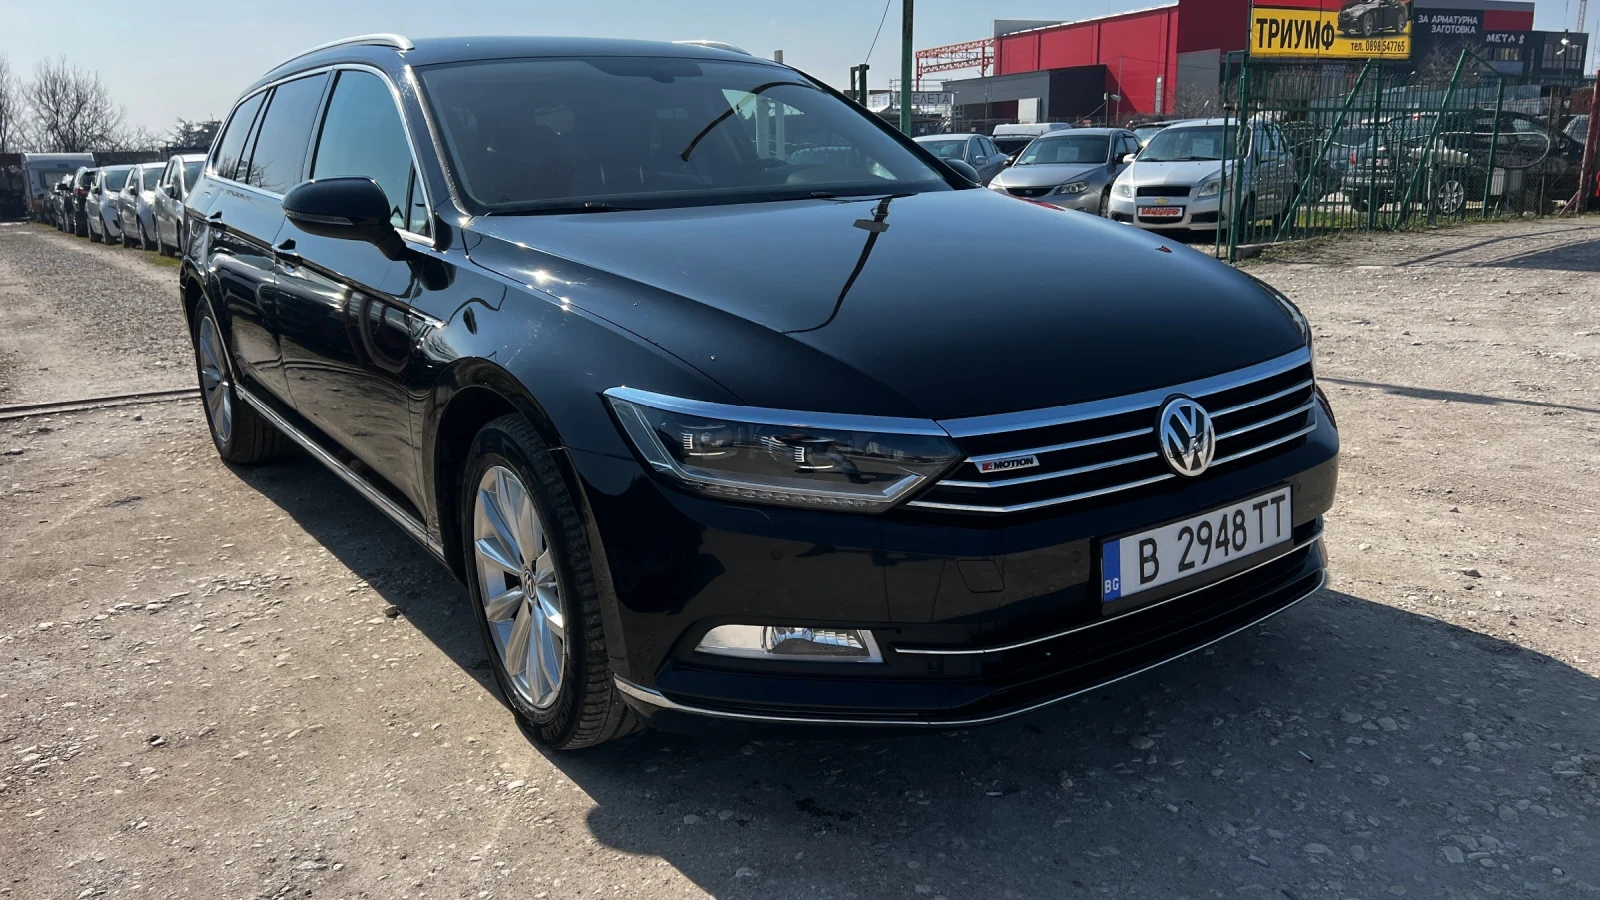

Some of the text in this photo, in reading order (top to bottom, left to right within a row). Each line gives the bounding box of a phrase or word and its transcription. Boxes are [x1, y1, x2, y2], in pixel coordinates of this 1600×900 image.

[1418, 14, 1478, 25] ЗА АРМАТУРНА
[1256, 18, 1335, 50] ТРИУМФ
[1431, 25, 1476, 34] ЗАГОТОВКА
[1351, 40, 1405, 52] тел. 0898 547765
[1139, 537, 1160, 585] B
[1105, 578, 1120, 594] BG
